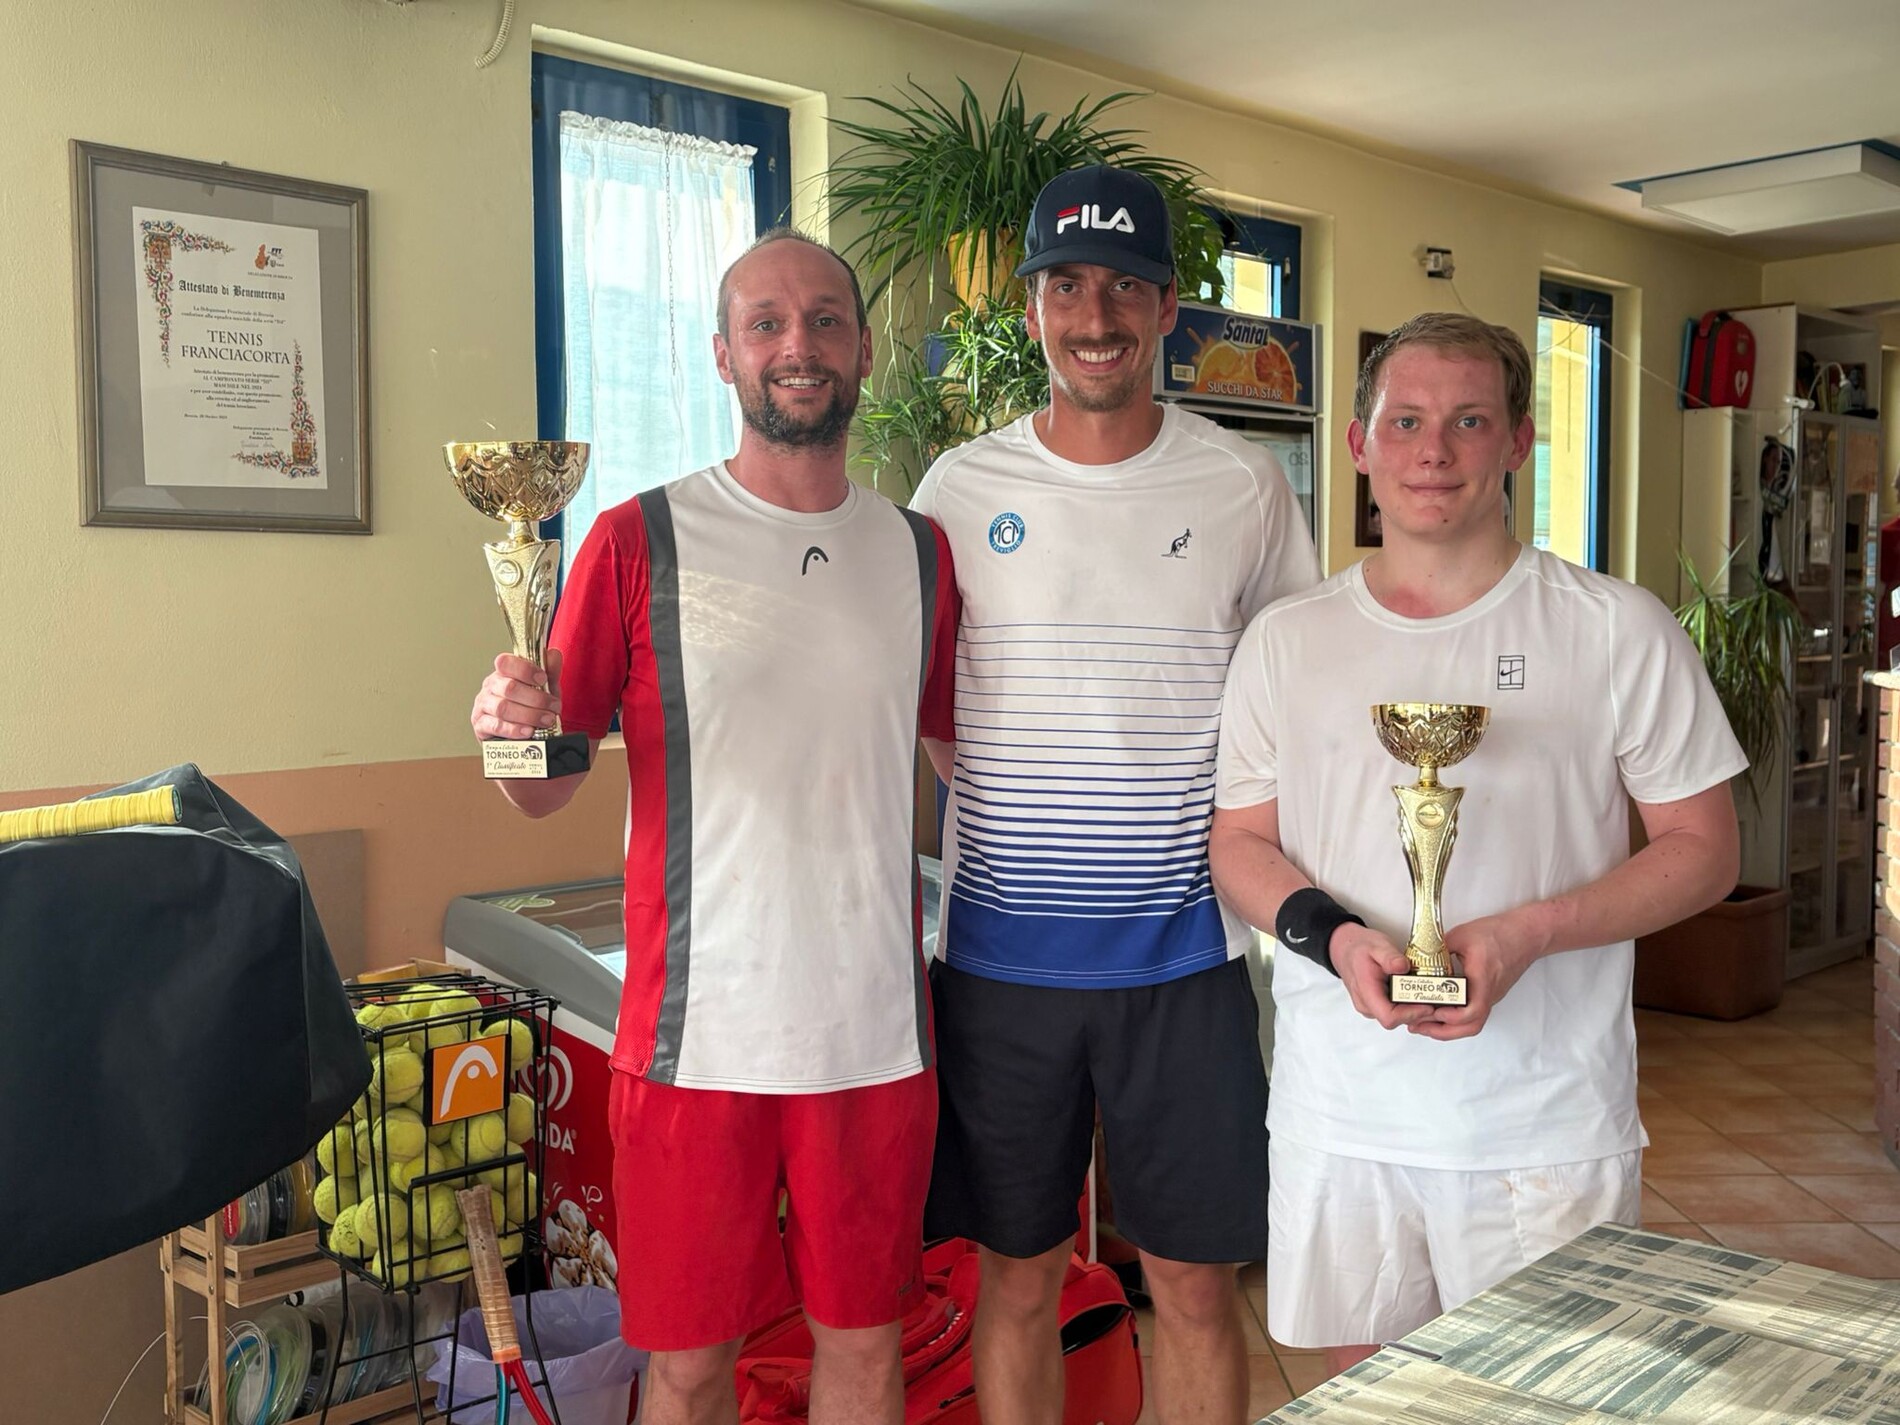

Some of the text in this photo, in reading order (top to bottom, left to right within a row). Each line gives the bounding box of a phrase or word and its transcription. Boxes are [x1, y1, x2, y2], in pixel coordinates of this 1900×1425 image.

[1056, 203, 1135, 235] FILA
[178, 279, 286, 302] Attestato di Benemerenza
[206, 329, 263, 347] TENNIS
[1223, 316, 1269, 346] Santal
[181, 345, 290, 365] FRANCIACORTA
[1207, 380, 1283, 400] SUCCHI DA STAR
[994, 520, 1019, 545] TCT
[486, 750, 520, 760] TORNEO
[493, 761, 527, 772] Classificato
[1400, 983, 1435, 992] TORNEO
[1413, 992, 1444, 1002] Finalista
